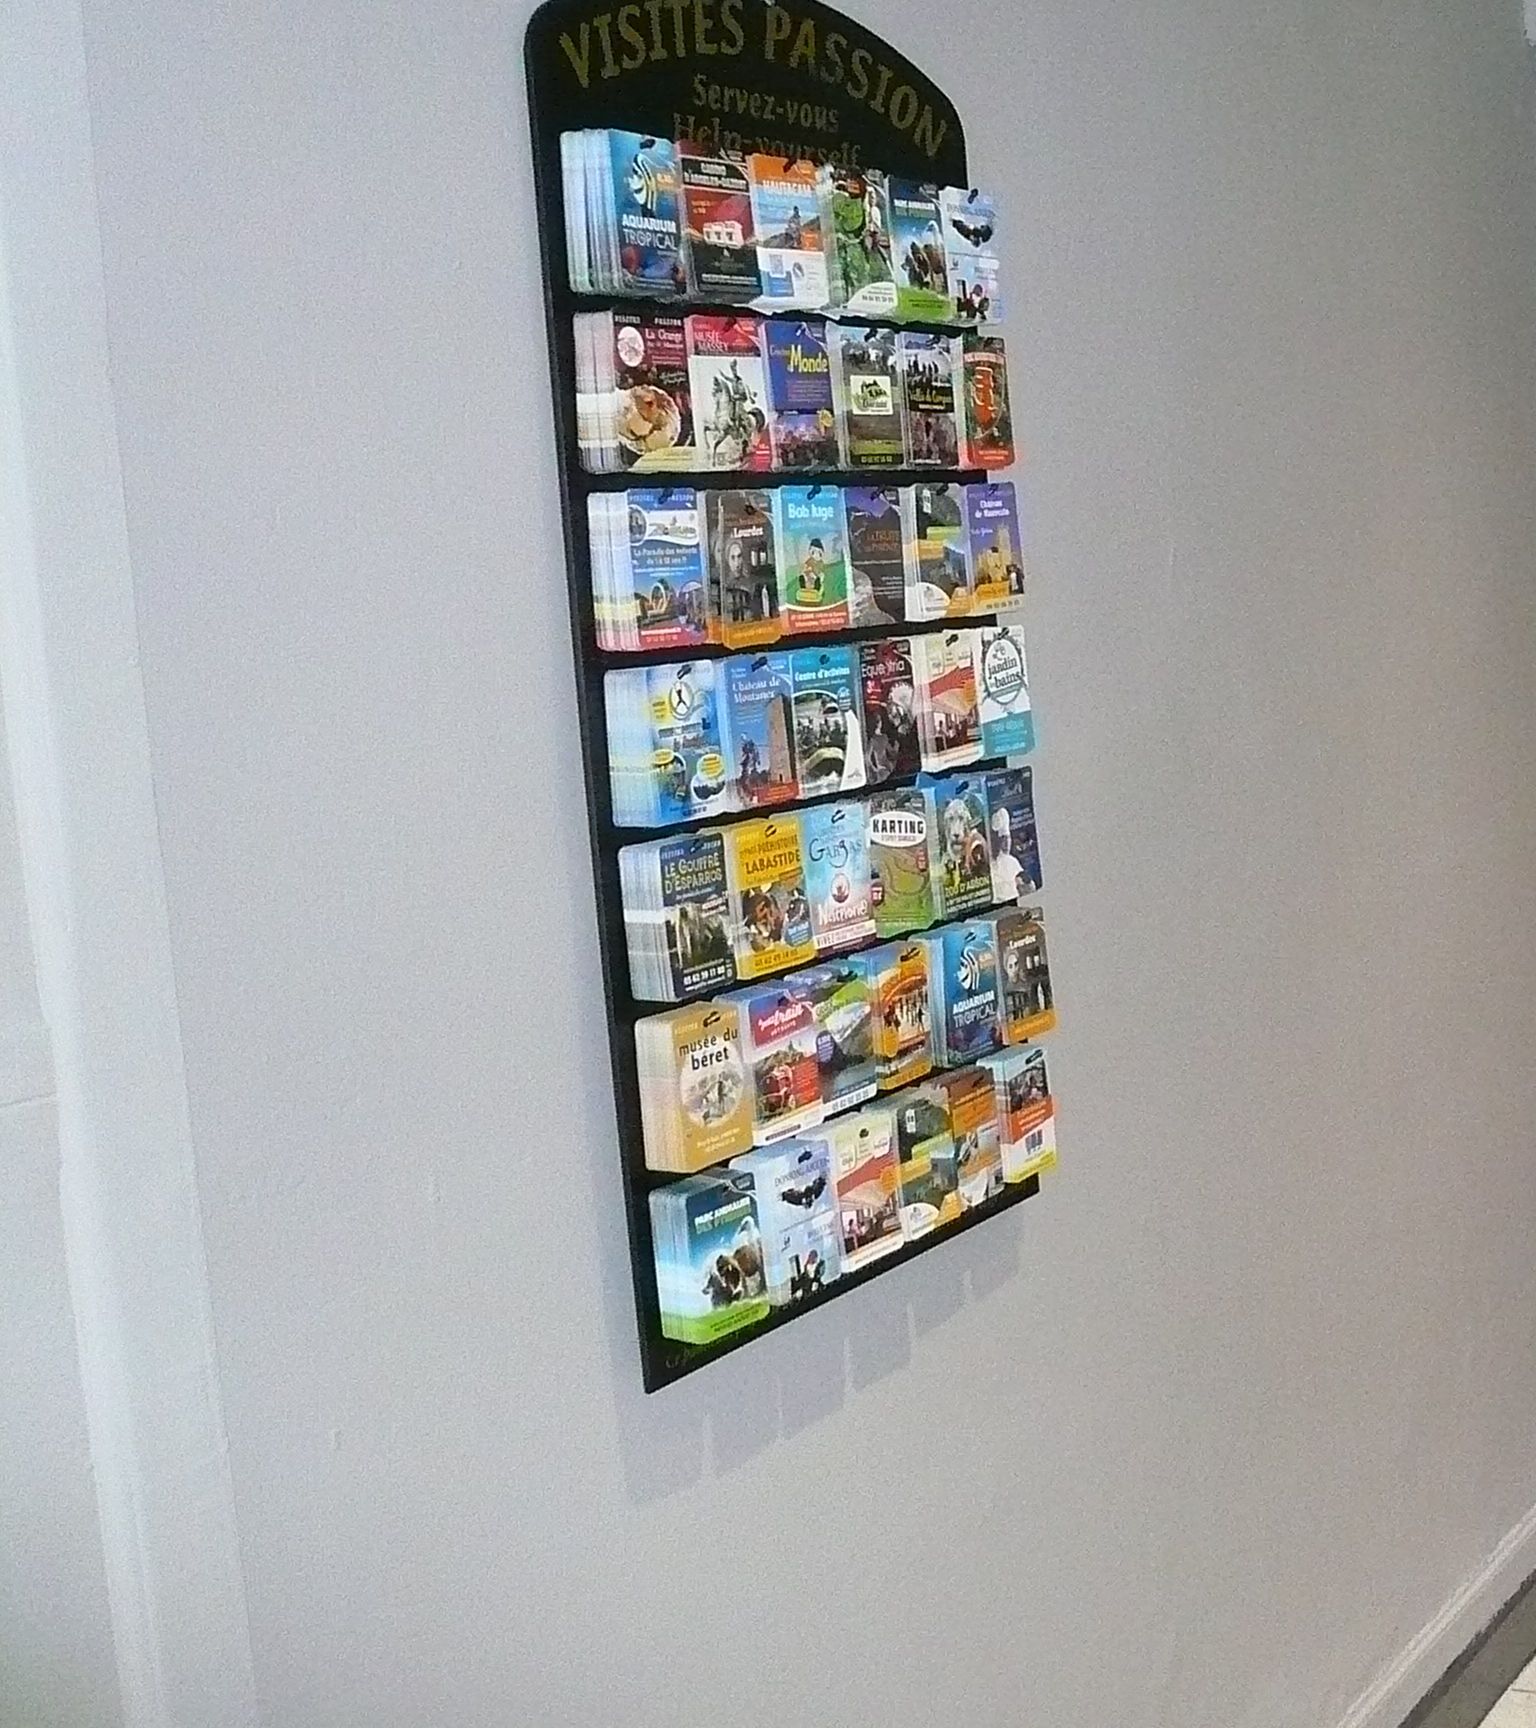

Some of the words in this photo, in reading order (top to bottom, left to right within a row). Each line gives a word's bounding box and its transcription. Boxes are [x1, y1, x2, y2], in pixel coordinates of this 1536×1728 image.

[560, 0, 745, 88] VISITES
[763, 5, 946, 158] PASSION
[693, 73, 840, 134] Servez-vous
[622, 212, 677, 234] AQUARIUM
[623, 227, 680, 251] TROPICAL
[787, 344, 829, 375] Monde
[788, 503, 810, 520] Bob
[987, 656, 1018, 680] jardin
[872, 818, 925, 834] KARTING
[664, 862, 676, 878] LE
[744, 848, 801, 875] LABASTIDE
[952, 989, 995, 1015] AQUARIUM
[953, 1002, 997, 1029] TROPICAL
[679, 1035, 718, 1057] musée
[723, 1027, 739, 1042] du
[691, 1045, 730, 1071] béret
